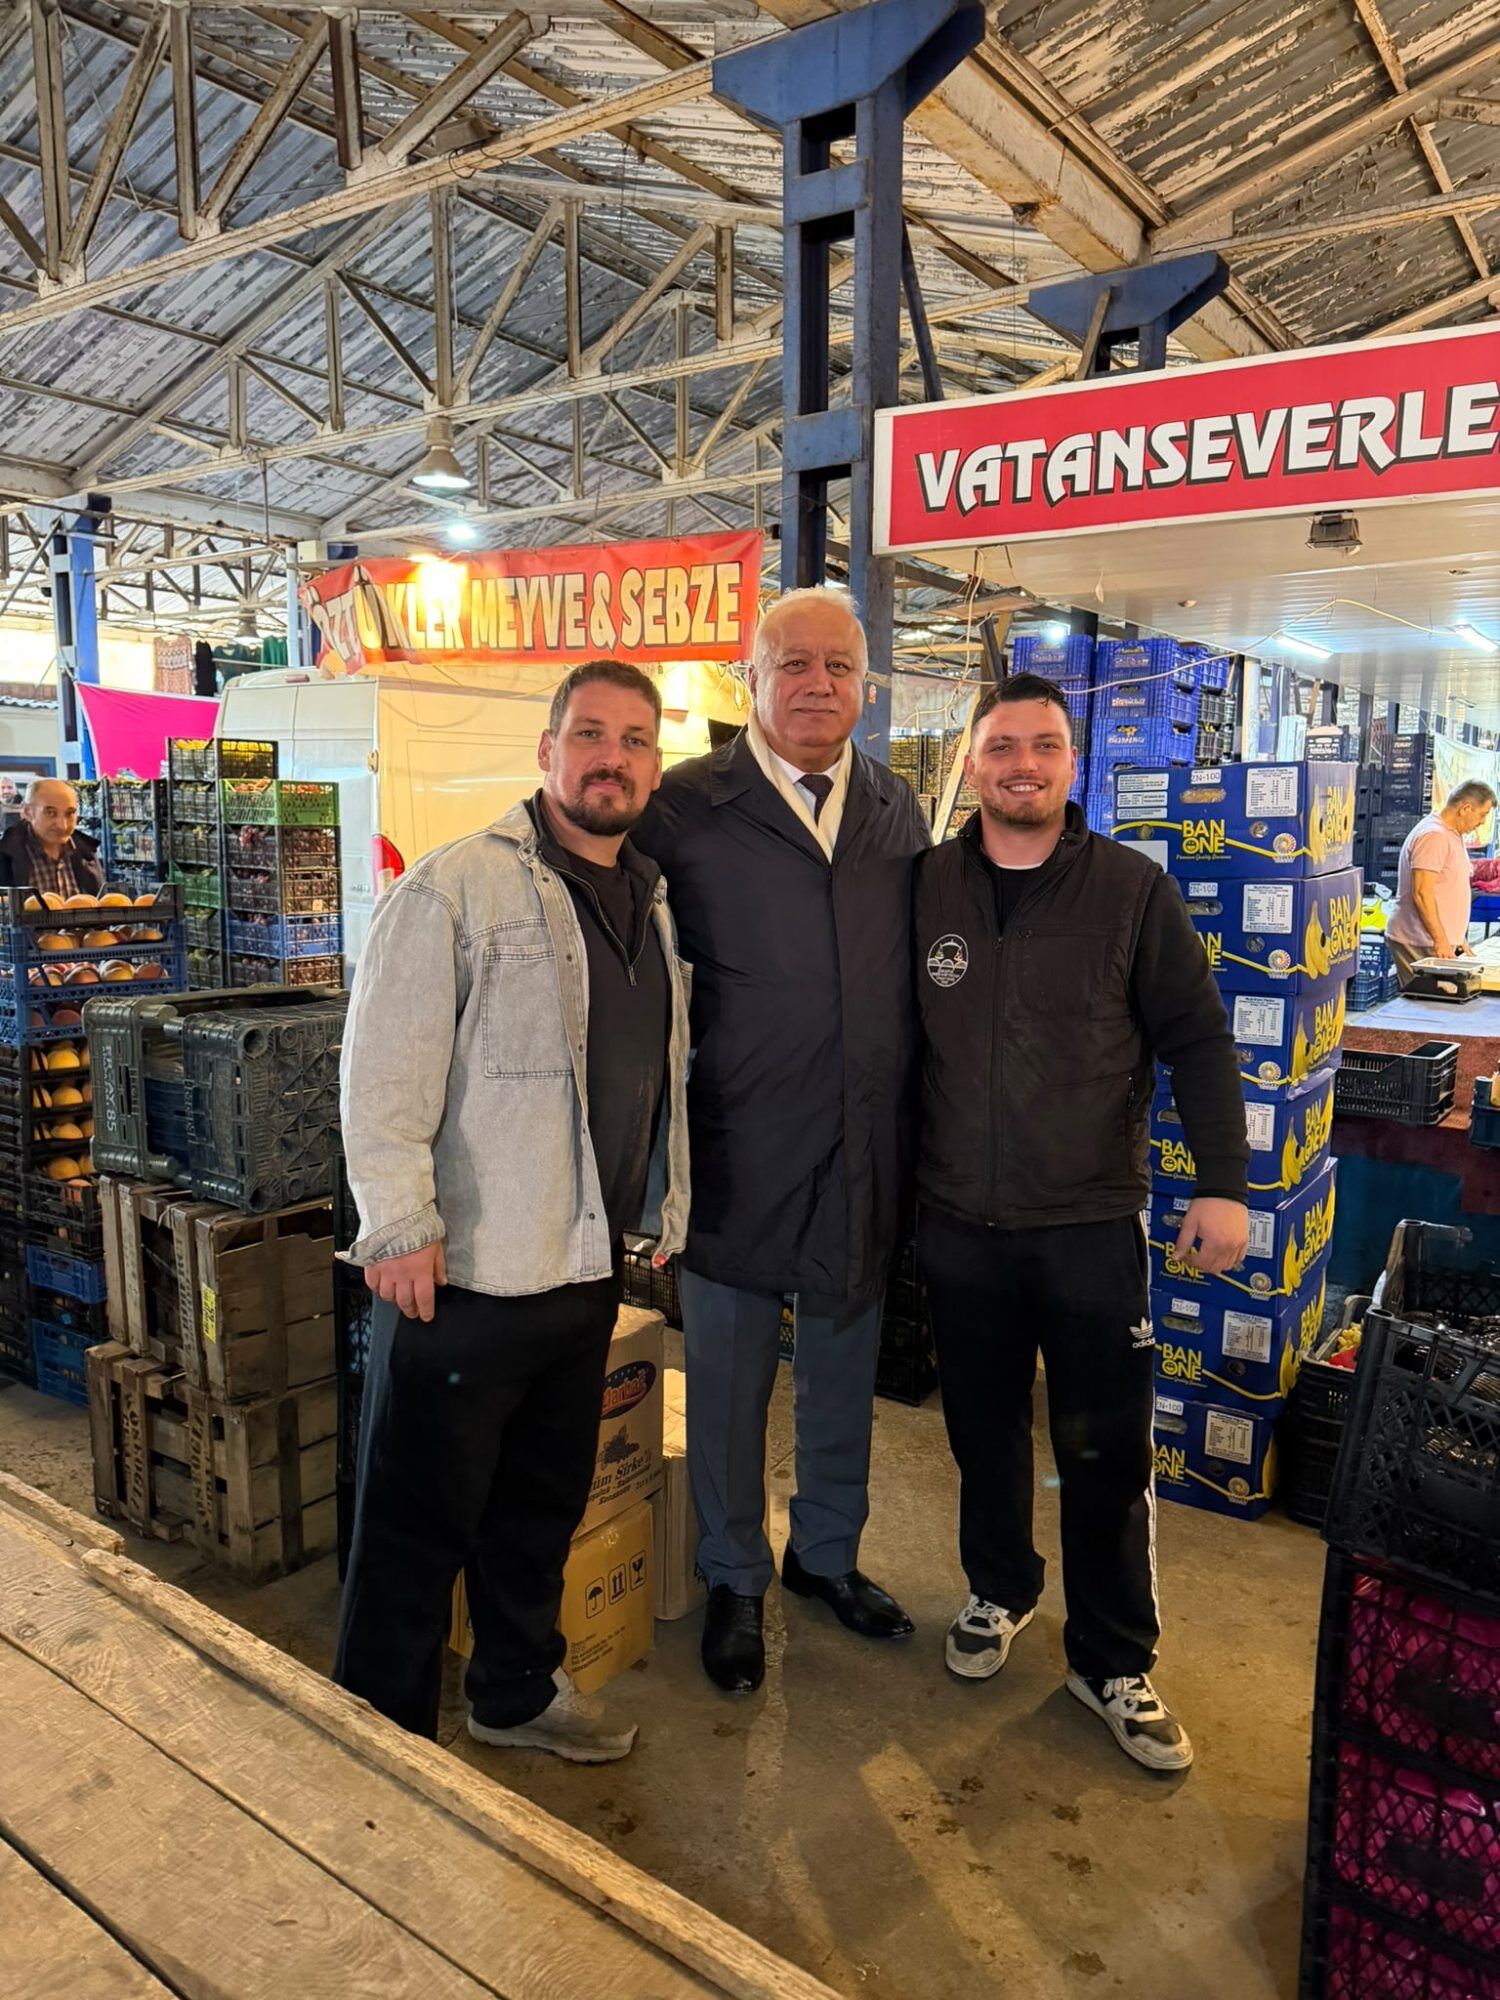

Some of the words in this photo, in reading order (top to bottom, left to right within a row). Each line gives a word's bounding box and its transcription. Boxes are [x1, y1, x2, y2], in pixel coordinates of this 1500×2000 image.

[1182, 819, 1225, 838] BAN
[1182, 836, 1225, 855] ONE
[1329, 894, 1351, 927] BAN
[1330, 923, 1351, 957] ONE
[1315, 998, 1335, 1036] BAN
[1162, 1343, 1202, 1365] BAN
[1161, 1358, 1202, 1381] ONE
[1154, 1444, 1185, 1466] AN
